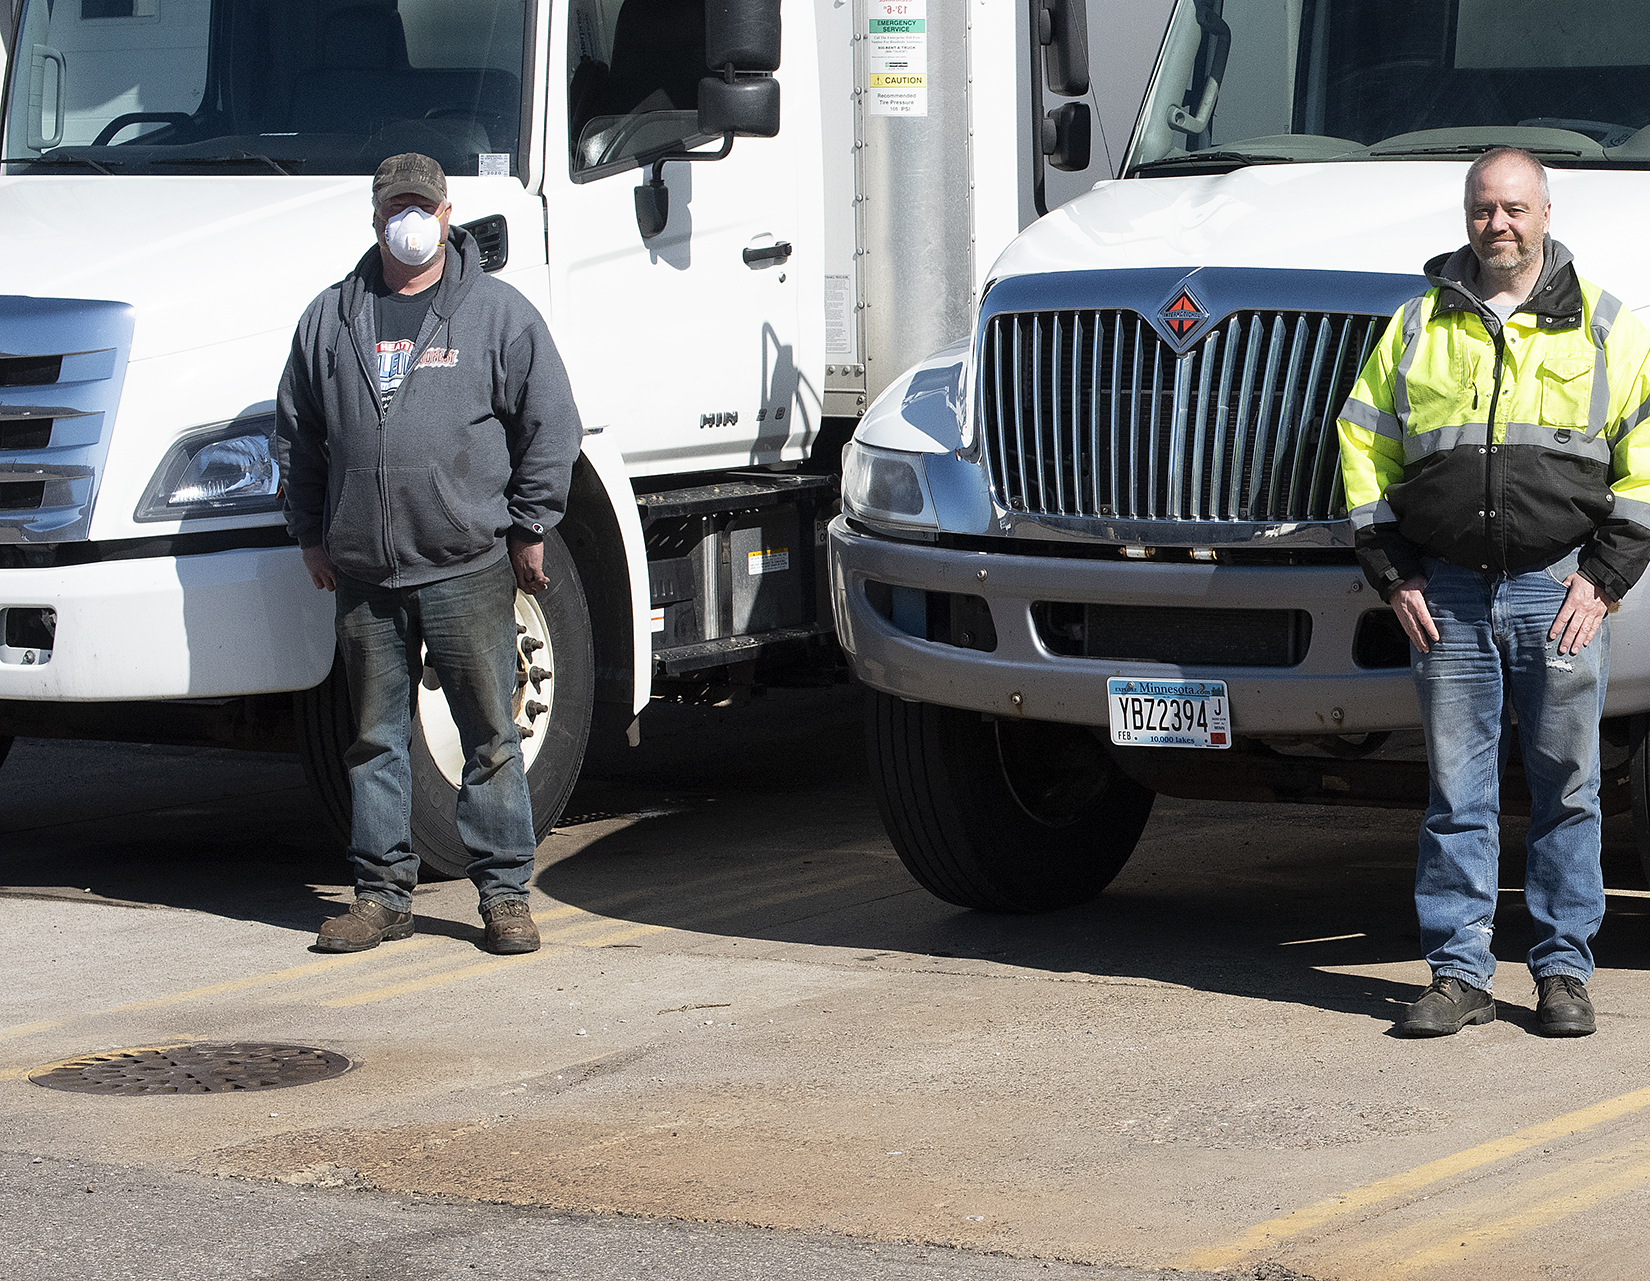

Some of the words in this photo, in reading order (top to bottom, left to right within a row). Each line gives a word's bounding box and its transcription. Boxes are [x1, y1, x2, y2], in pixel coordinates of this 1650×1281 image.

[1139, 682, 1210, 695] Minnesota.com
[1118, 697, 1208, 733] YBZ2394
[1214, 699, 1221, 716] J
[1118, 731, 1131, 740] FEB
[1150, 736, 1174, 744] 10,000
[1176, 736, 1195, 744] lakes
